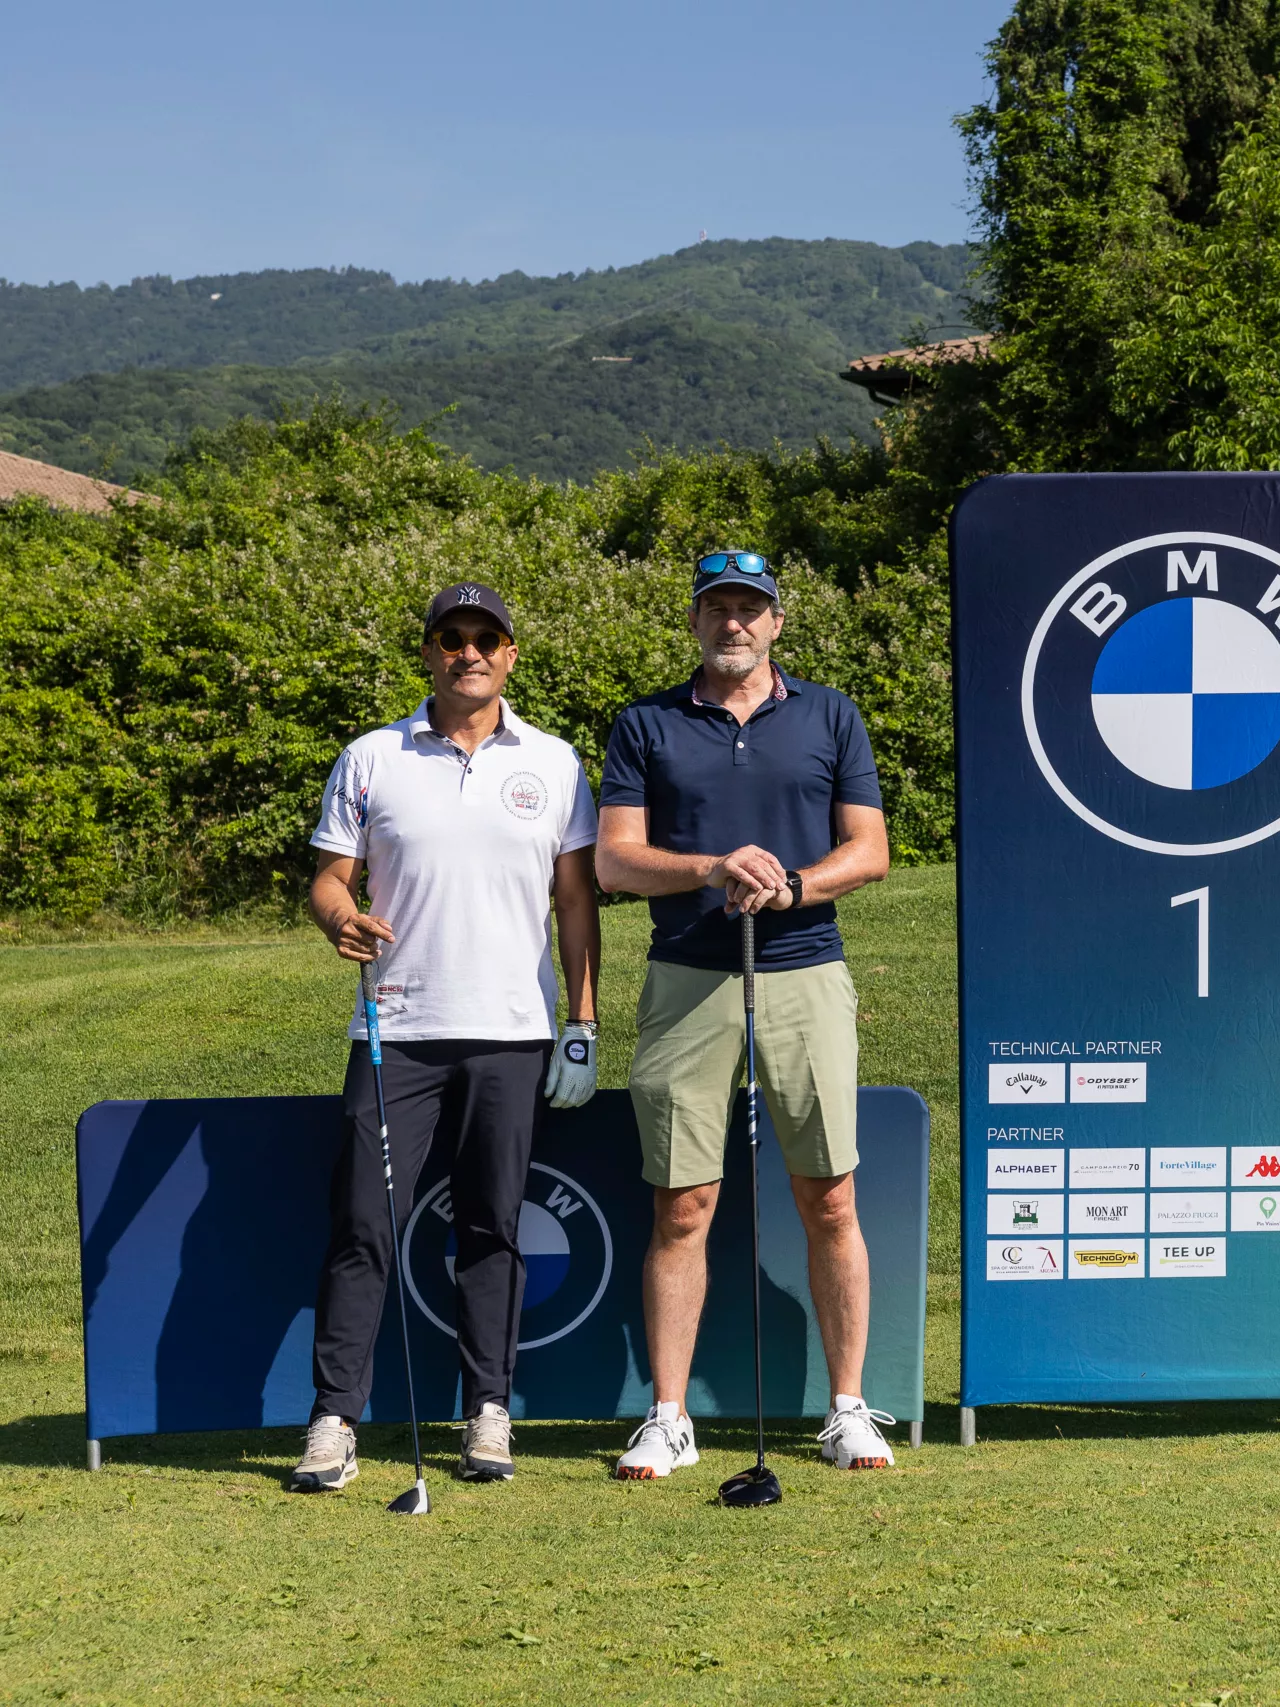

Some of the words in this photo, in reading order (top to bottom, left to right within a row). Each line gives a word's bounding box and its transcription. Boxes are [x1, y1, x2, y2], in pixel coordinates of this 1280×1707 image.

[1170, 886, 1209, 998] 1
[989, 1041, 1081, 1056] TECHNICAL
[1086, 1041, 1162, 1055] PARTNER
[1005, 1072, 1048, 1087] Callaway
[987, 1127, 1064, 1141] PARTNER
[995, 1165, 1057, 1173] ALPHABET
[1128, 1163, 1140, 1171] 70
[1163, 1247, 1189, 1257] TEE
[1195, 1246, 1215, 1257] UP
